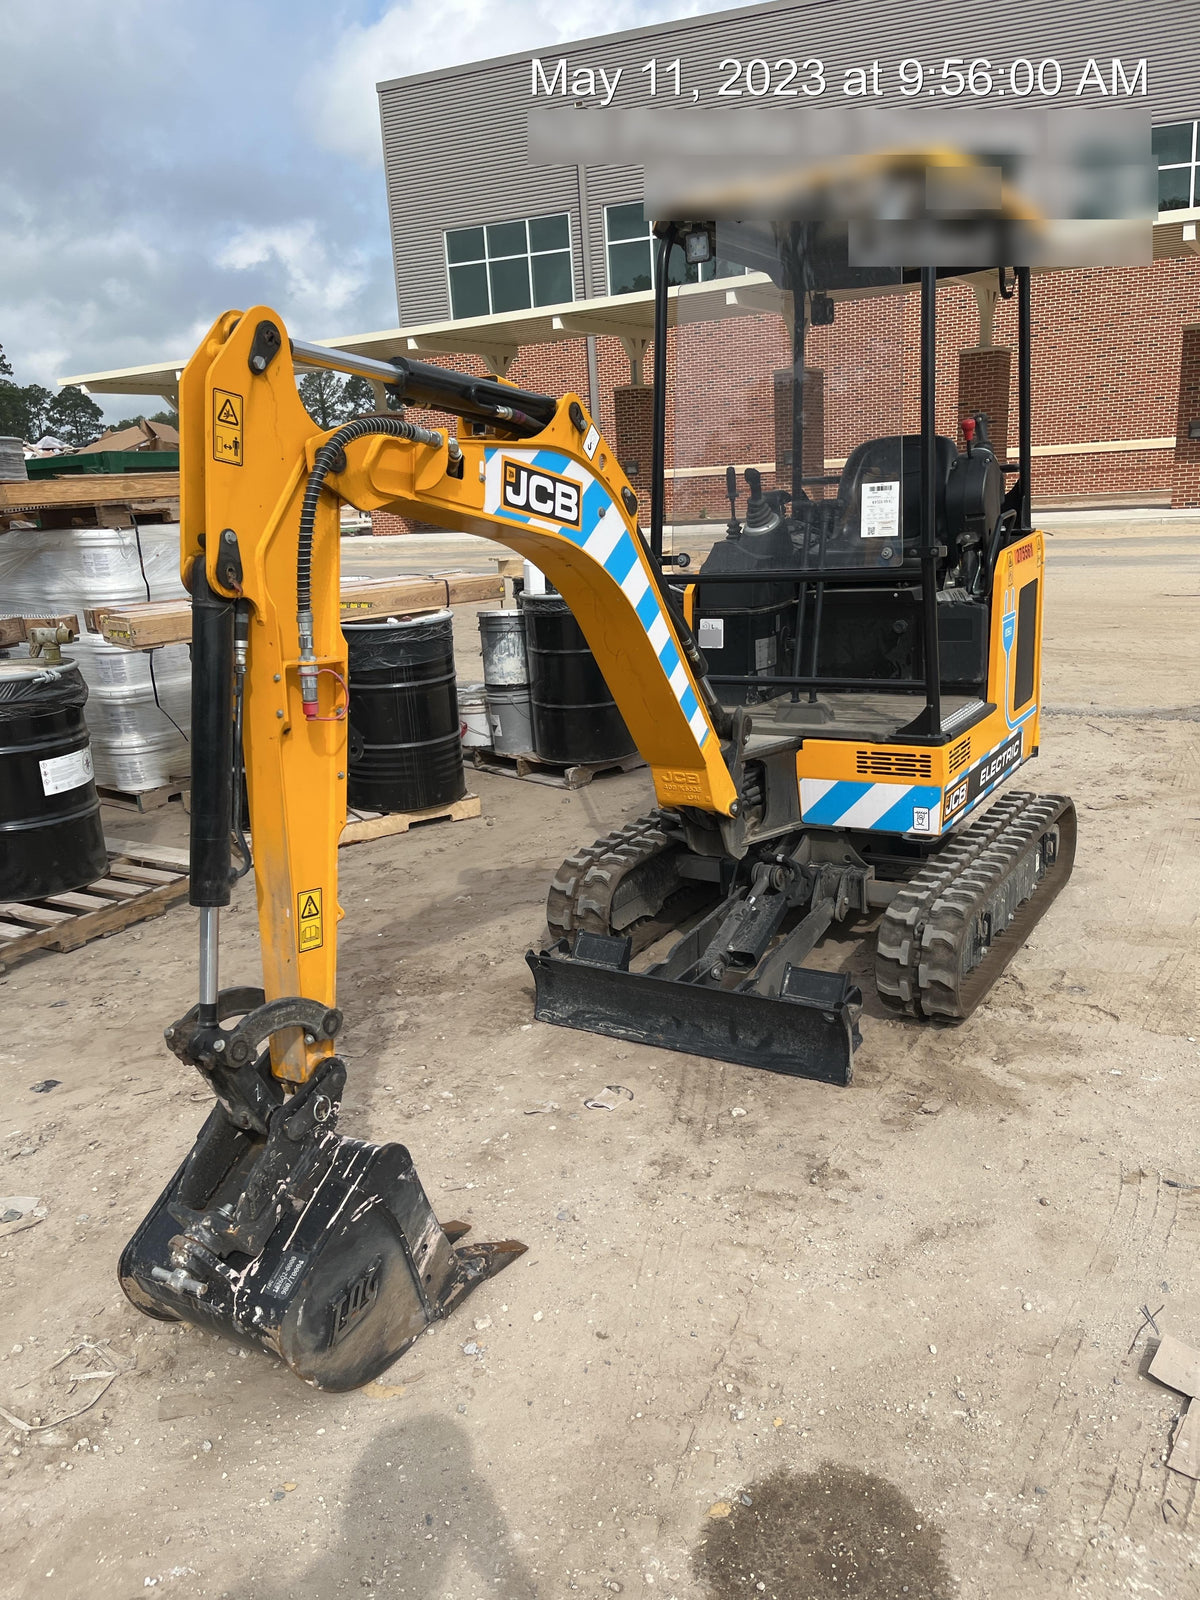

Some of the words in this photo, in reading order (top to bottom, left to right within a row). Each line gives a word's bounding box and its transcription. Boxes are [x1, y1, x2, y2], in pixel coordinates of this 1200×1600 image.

[505, 470, 579, 521] JCB
[661, 771, 700, 785] JCB
[980, 740, 1020, 787] ELECTRIC
[945, 783, 968, 816] JCB
